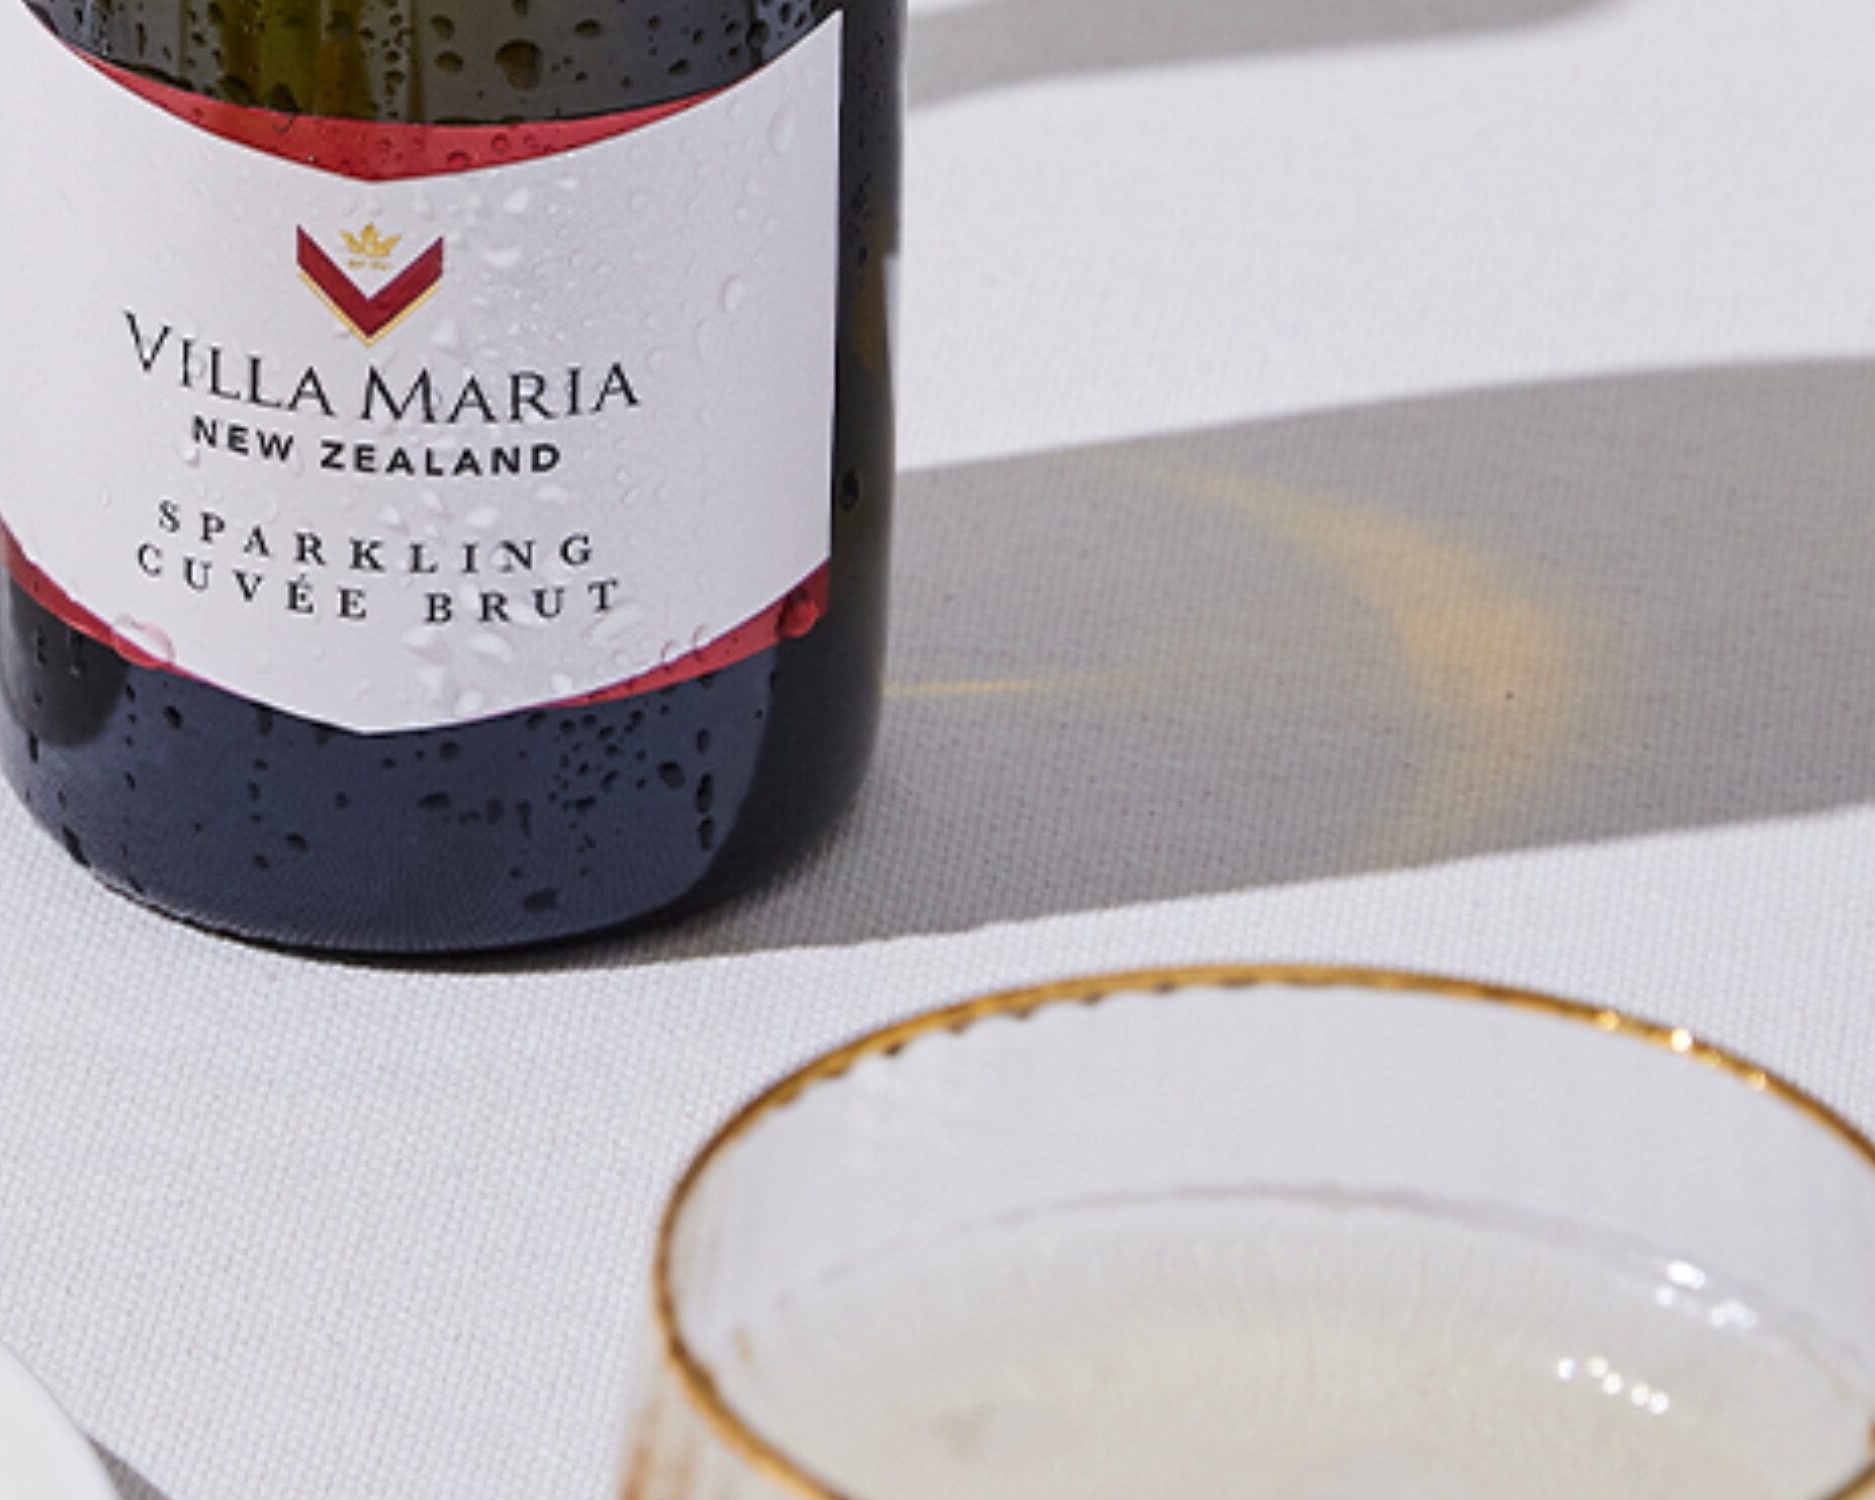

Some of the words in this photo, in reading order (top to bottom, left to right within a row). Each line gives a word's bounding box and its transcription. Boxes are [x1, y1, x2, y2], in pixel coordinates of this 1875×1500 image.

[123, 309, 334, 418] VILLA
[359, 361, 642, 425] MARIA
[191, 414, 295, 463] NEW
[319, 440, 562, 478] ZEALAND
[157, 498, 595, 576] SPARKLING
[136, 543, 367, 620] CUVÉE
[424, 578, 621, 625] BRUT
